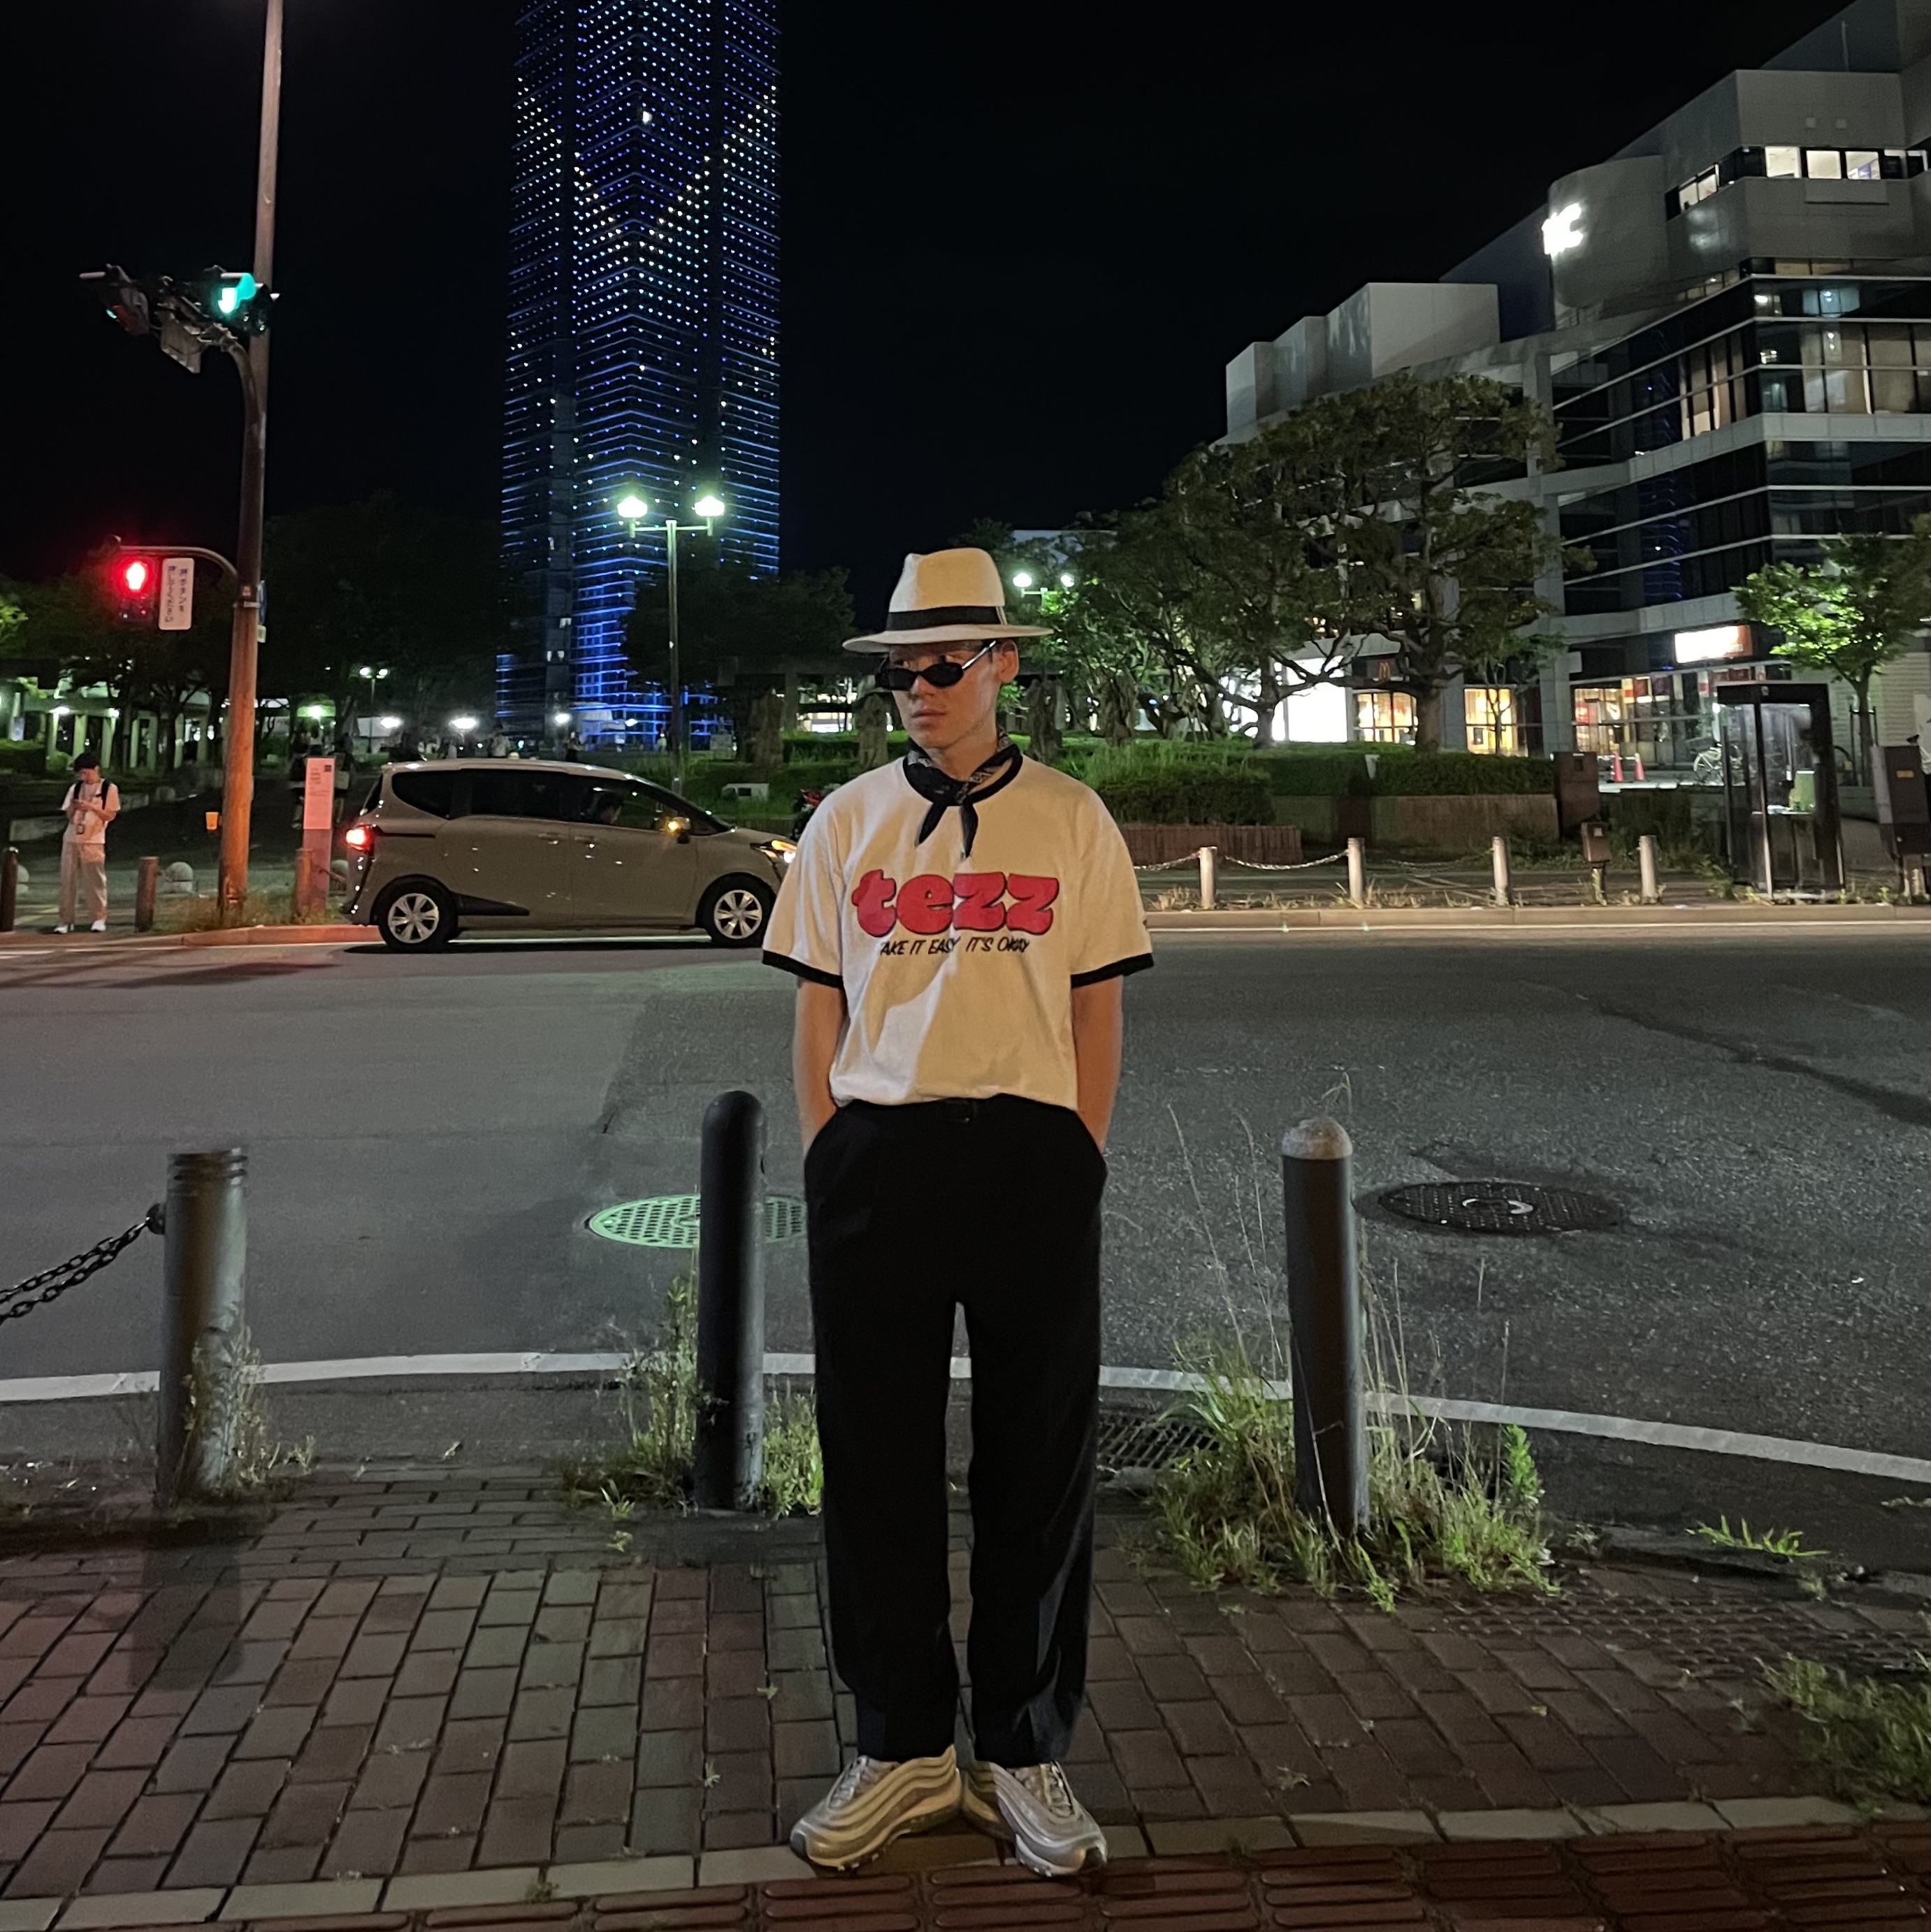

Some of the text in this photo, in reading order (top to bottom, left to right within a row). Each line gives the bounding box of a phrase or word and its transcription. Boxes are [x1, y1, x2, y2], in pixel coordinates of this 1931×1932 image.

[851, 869, 1059, 937] tezz
[880, 940, 909, 955] AKE
[909, 940, 927, 955] IT
[928, 936, 961, 954] EASY
